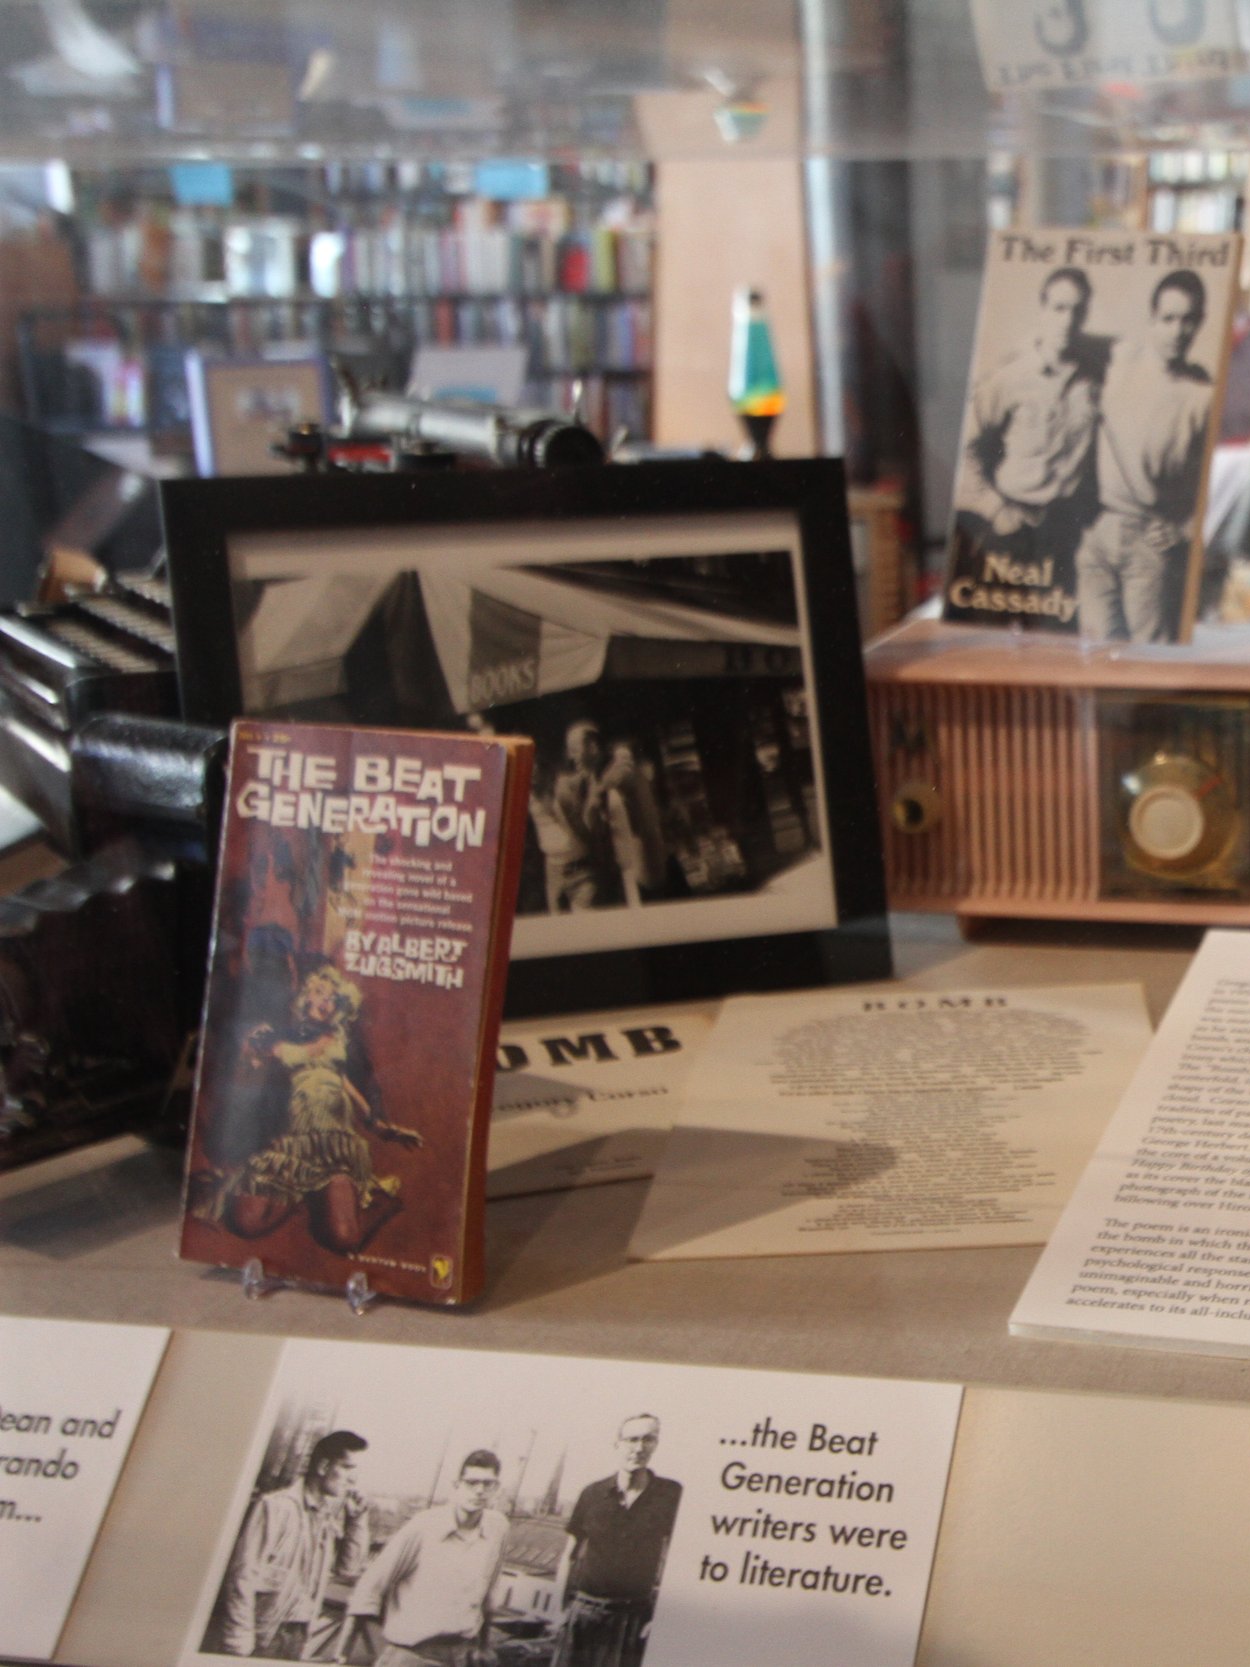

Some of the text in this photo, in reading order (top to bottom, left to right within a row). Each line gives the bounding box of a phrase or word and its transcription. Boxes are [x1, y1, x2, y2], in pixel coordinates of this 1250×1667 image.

[1001, 235, 1230, 268] The First Third
[984, 552, 1054, 588] Neal
[951, 577, 1081, 624] Cassady
[247, 746, 481, 802] THE BEAT
[236, 782, 486, 851] GENERATION
[344, 930, 468, 963] BY ALBERT
[344, 952, 464, 990] ZUGSMITH
[496, 1026, 683, 1074] OMB
[1065, 1298, 1145, 1311] accelerates
[1149, 1304, 1165, 1313] to
[1168, 1305, 1186, 1314] its
[1071, 1284, 1118, 1296] poem,
[1122, 1288, 1195, 1303] especially
[1199, 1294, 1239, 1304] when
[0, 1406, 122, 1439] ean and
[720, 1416, 878, 1456] ...the Beat
[721, 1461, 894, 1503] Generation
[711, 1508, 907, 1551] writers were
[700, 1551, 892, 1597] to literature.
